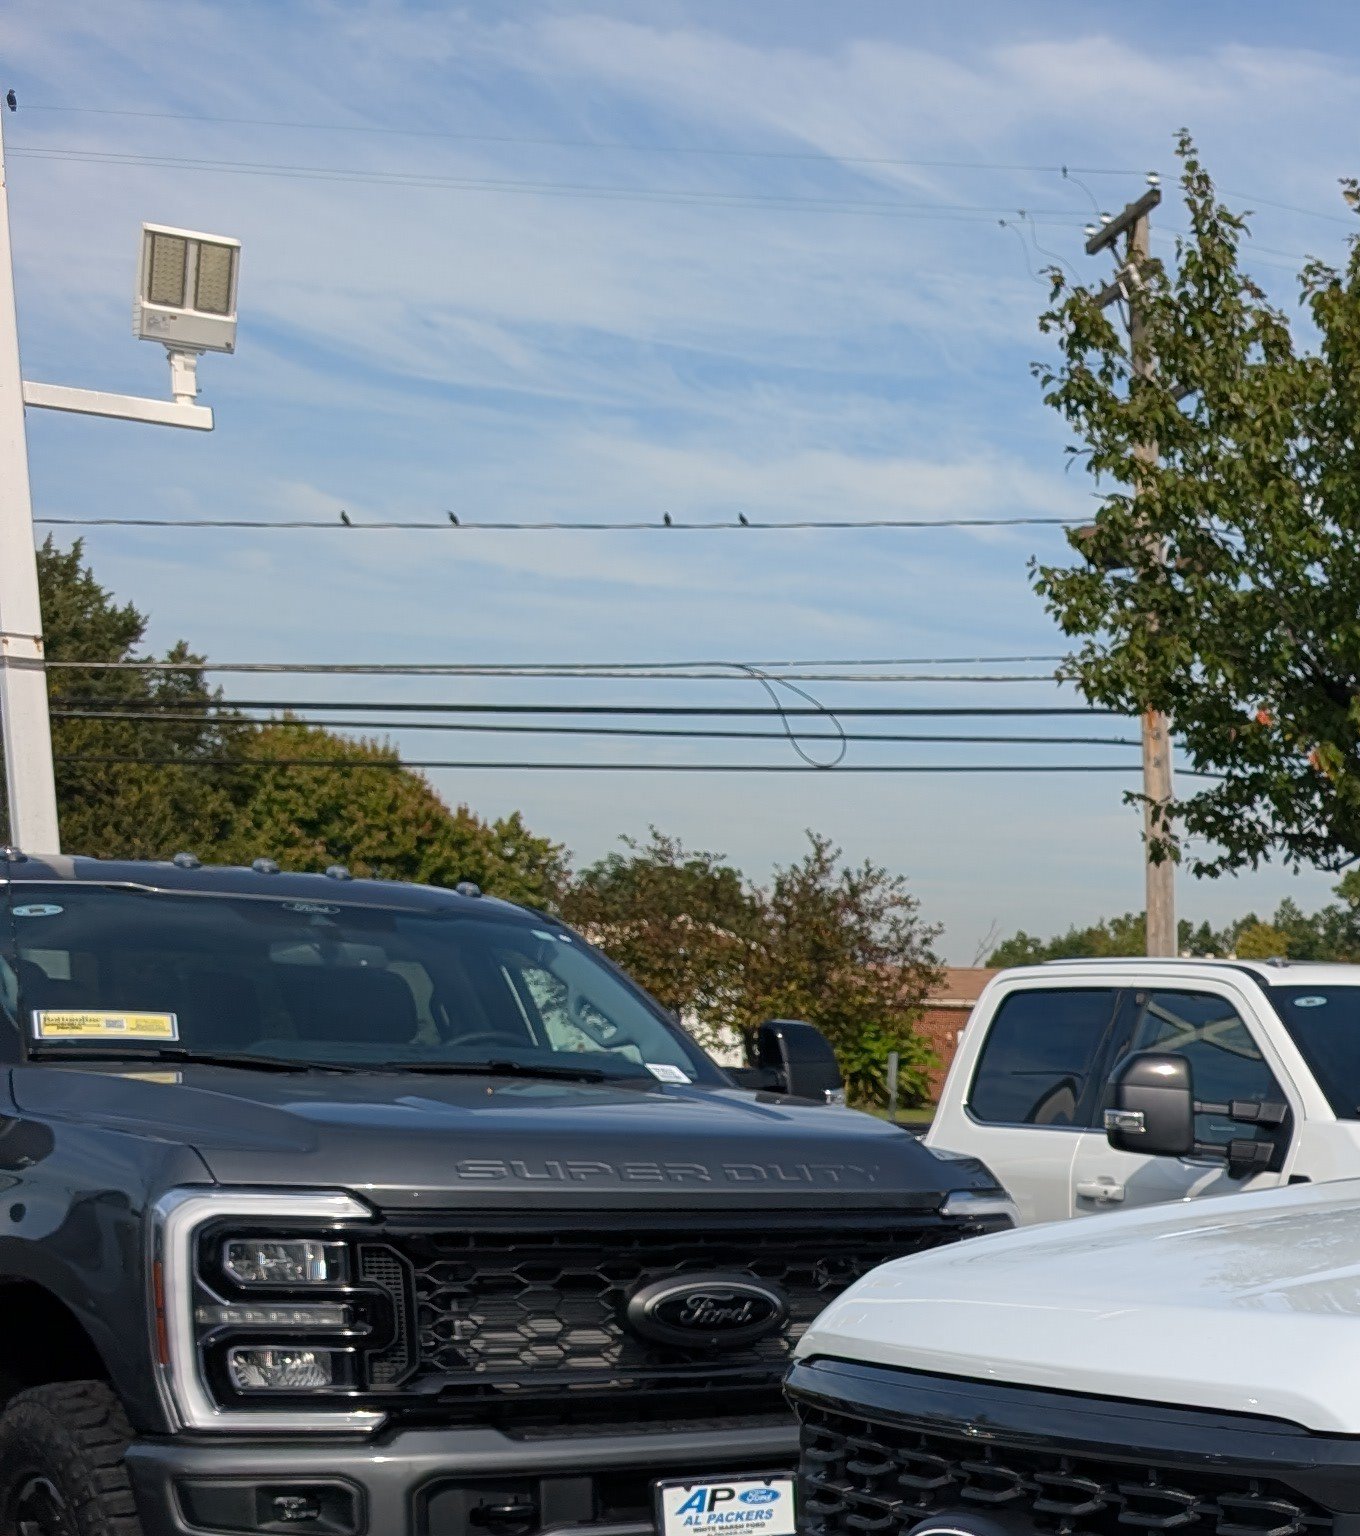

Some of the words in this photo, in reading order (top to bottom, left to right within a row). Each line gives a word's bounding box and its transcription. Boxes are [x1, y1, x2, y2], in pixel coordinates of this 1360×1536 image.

[455, 1159, 712, 1183] SUPER
[720, 1163, 882, 1184] DUTY
[680, 1293, 752, 1324] Ford
[675, 1487, 735, 1516] AP
[746, 1490, 773, 1503] Ford
[683, 1515, 702, 1526] AL
[706, 1508, 774, 1524] PACKERS
[693, 1526, 716, 1534] WHITE
[718, 1523, 744, 1531] MARSH
[745, 1521, 766, 1529] FORD
